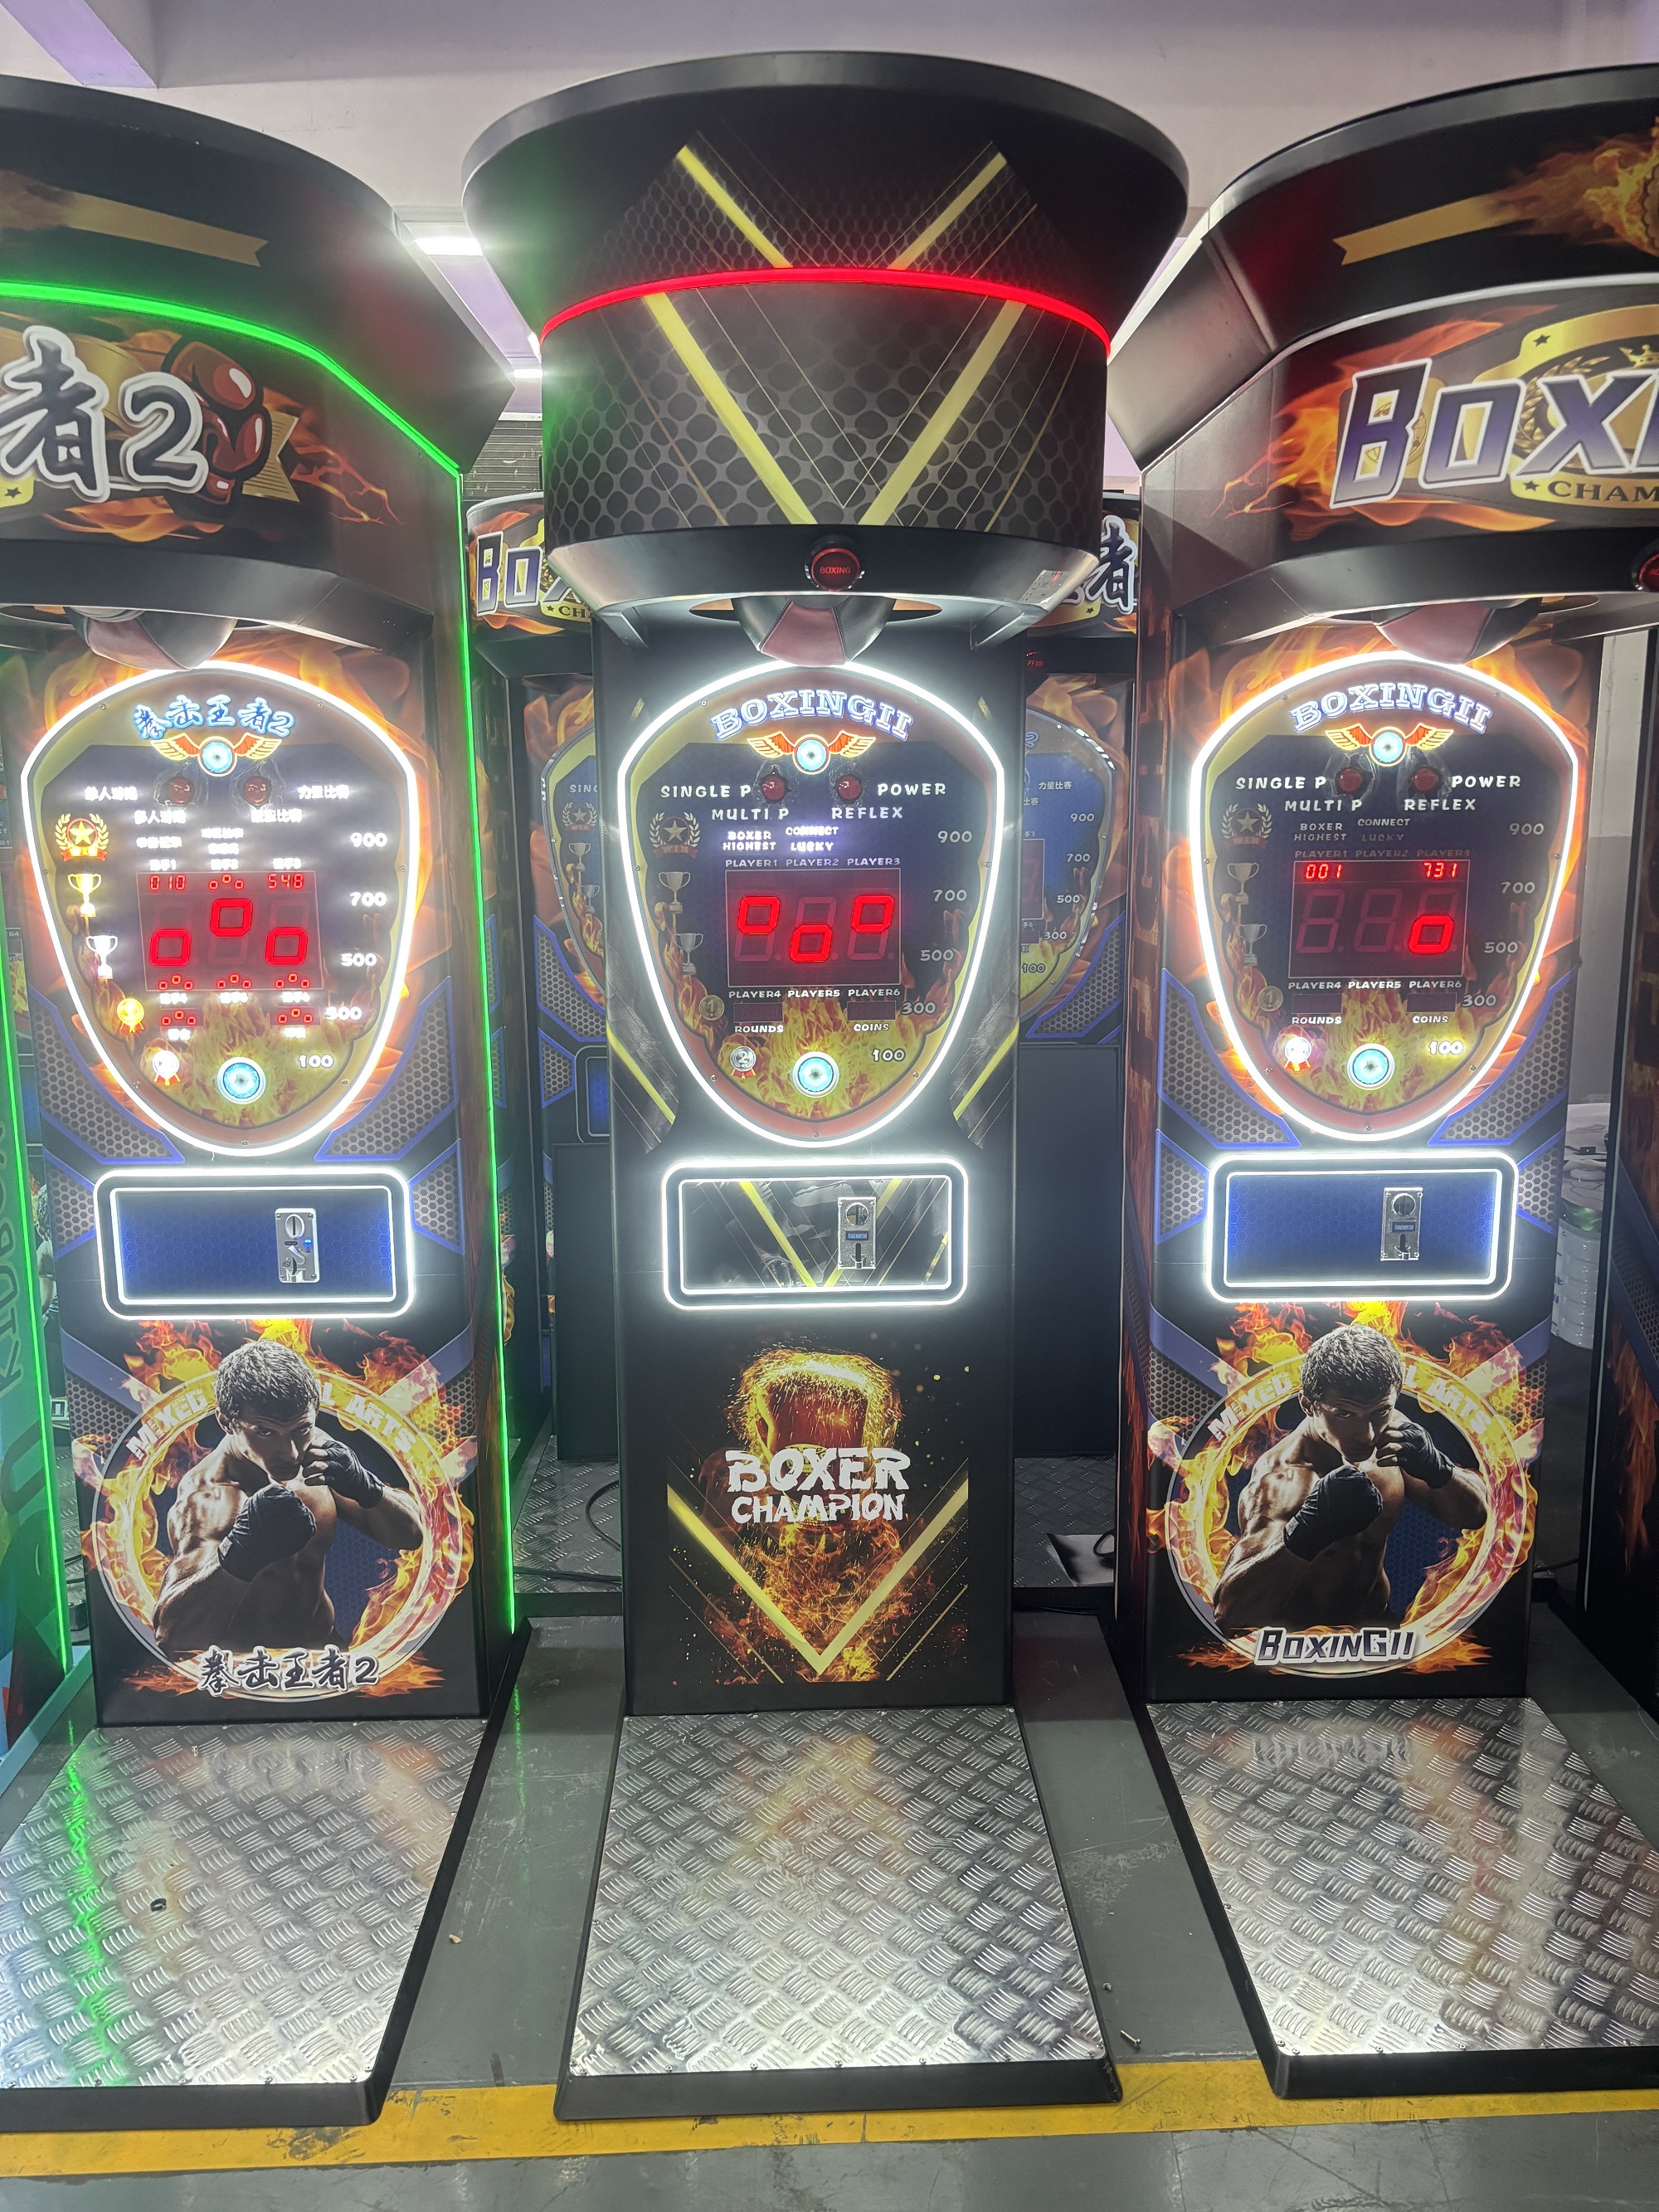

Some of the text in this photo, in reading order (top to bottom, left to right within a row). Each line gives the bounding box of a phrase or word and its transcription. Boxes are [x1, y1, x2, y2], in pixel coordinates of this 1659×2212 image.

[709, 689, 913, 740] BOXINGII
[1288, 682, 1492, 734] BOXINGII
[133, 694, 294, 739] 拳击王者2
[1039, 781, 1072, 790] 力量比赛
[1236, 776, 1326, 789] SINGLE P
[1451, 775, 1521, 788] POWER
[660, 784, 752, 797] SINGLE P
[878, 783, 946, 796] POWER
[1284, 800, 1363, 811] MULTI P
[1404, 799, 1476, 811] REFLEX
[712, 808, 789, 821] MULTI P
[832, 807, 903, 819] REFLEX
[1070, 813, 1095, 822] 900
[1300, 822, 1343, 831] BOXER
[1357, 818, 1410, 826] CONNECT
[727, 831, 771, 840] BOXER
[786, 826, 839, 836] CONNECT
[1509, 823, 1545, 836] 900
[350, 833, 388, 847] 900
[937, 830, 972, 843] 900
[1294, 833, 1347, 841] HIGHEST
[1361, 833, 1404, 842] LUCKY
[791, 841, 834, 851] LUCKY
[1066, 853, 1091, 863] 700
[1294, 849, 1471, 858] PLAYER1 PLAYER2 PLAYER3
[725, 858, 901, 868] PLAYER1 PLAYER2 PLAYER3
[1304, 863, 1342, 880] 001
[1422, 861, 1458, 879] 731
[267, 873, 305, 889] 548
[1501, 881, 1535, 894] 700
[350, 892, 387, 907] 700
[932, 889, 967, 902] 700
[1056, 894, 1080, 904] 500
[1043, 931, 1067, 939] 300
[1484, 941, 1518, 954] 500
[341, 953, 377, 967] 500
[920, 948, 955, 962] 500
[1022, 963, 1045, 973] 100
[1288, 980, 1462, 990] PLAYER4 PLAYER5 PLAYER6
[728, 990, 781, 998] PLAYER4
[787, 990, 840, 998] PLAYER5
[1462, 994, 1496, 1007] 300
[901, 1001, 937, 1015] 300
[1292, 1016, 1342, 1025] ROUNDS
[1413, 1015, 1448, 1023] COINS
[734, 1025, 784, 1034] ROUNDS
[854, 1023, 889, 1032] COINS
[1428, 1040, 1463, 1055] 100
[299, 1055, 333, 1068] 100
[737, 1050, 748, 1063] 2
[872, 1049, 905, 1062] 100
[1425, 1377, 1491, 1435] ARTS
[345, 1394, 416, 1453] ARTS
[725, 1447, 911, 1493] BOXER
[732, 1493, 906, 1524] CHAMPION
[197, 1644, 380, 1697] 拳击王者2
